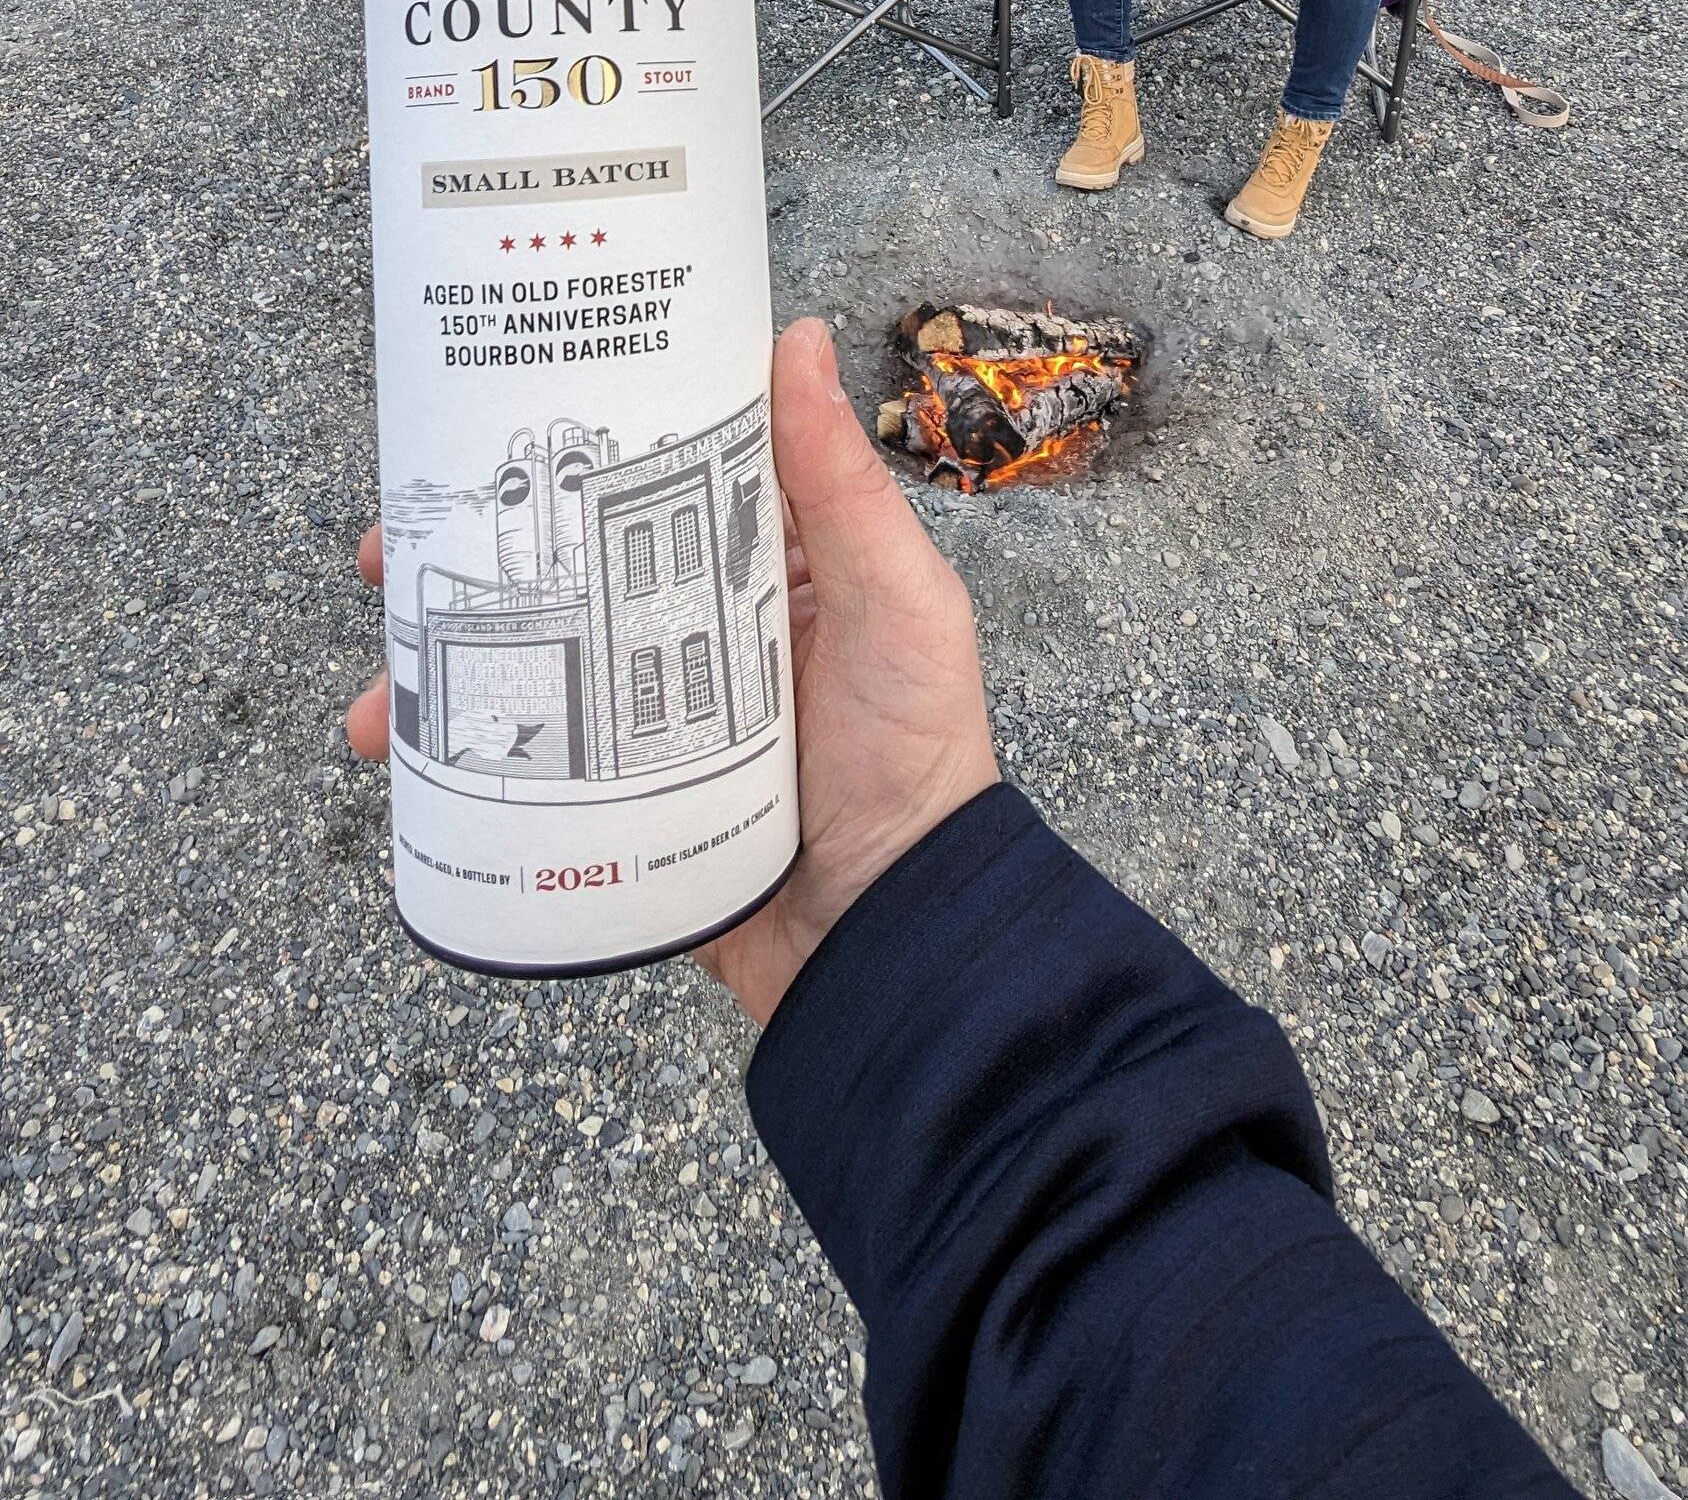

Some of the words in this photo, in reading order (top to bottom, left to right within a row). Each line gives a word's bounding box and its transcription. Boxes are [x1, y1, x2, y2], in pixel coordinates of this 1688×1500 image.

[407, 84, 456, 100] BRAND
[471, 54, 623, 112] 150
[644, 70, 693, 85] STOUT
[431, 170, 540, 194] SMALL
[552, 160, 670, 188] BATCH
[423, 284, 474, 305] AGED
[481, 282, 503, 304] IN
[511, 280, 559, 303] OLD
[503, 299, 672, 334] ANNIVERSARY
[445, 343, 554, 366] BOURBON
[562, 330, 669, 362] BARRELS
[648, 853, 677, 871] GOOSE
[679, 840, 709, 862] ISLAND
[711, 830, 730, 848] BEER
[730, 824, 741, 838] CO.
[743, 817, 750, 831] IN
[456, 867, 461, 878] &
[462, 868, 497, 885] BOTTLED
[499, 874, 511, 886] BY
[535, 861, 624, 891] 2021
